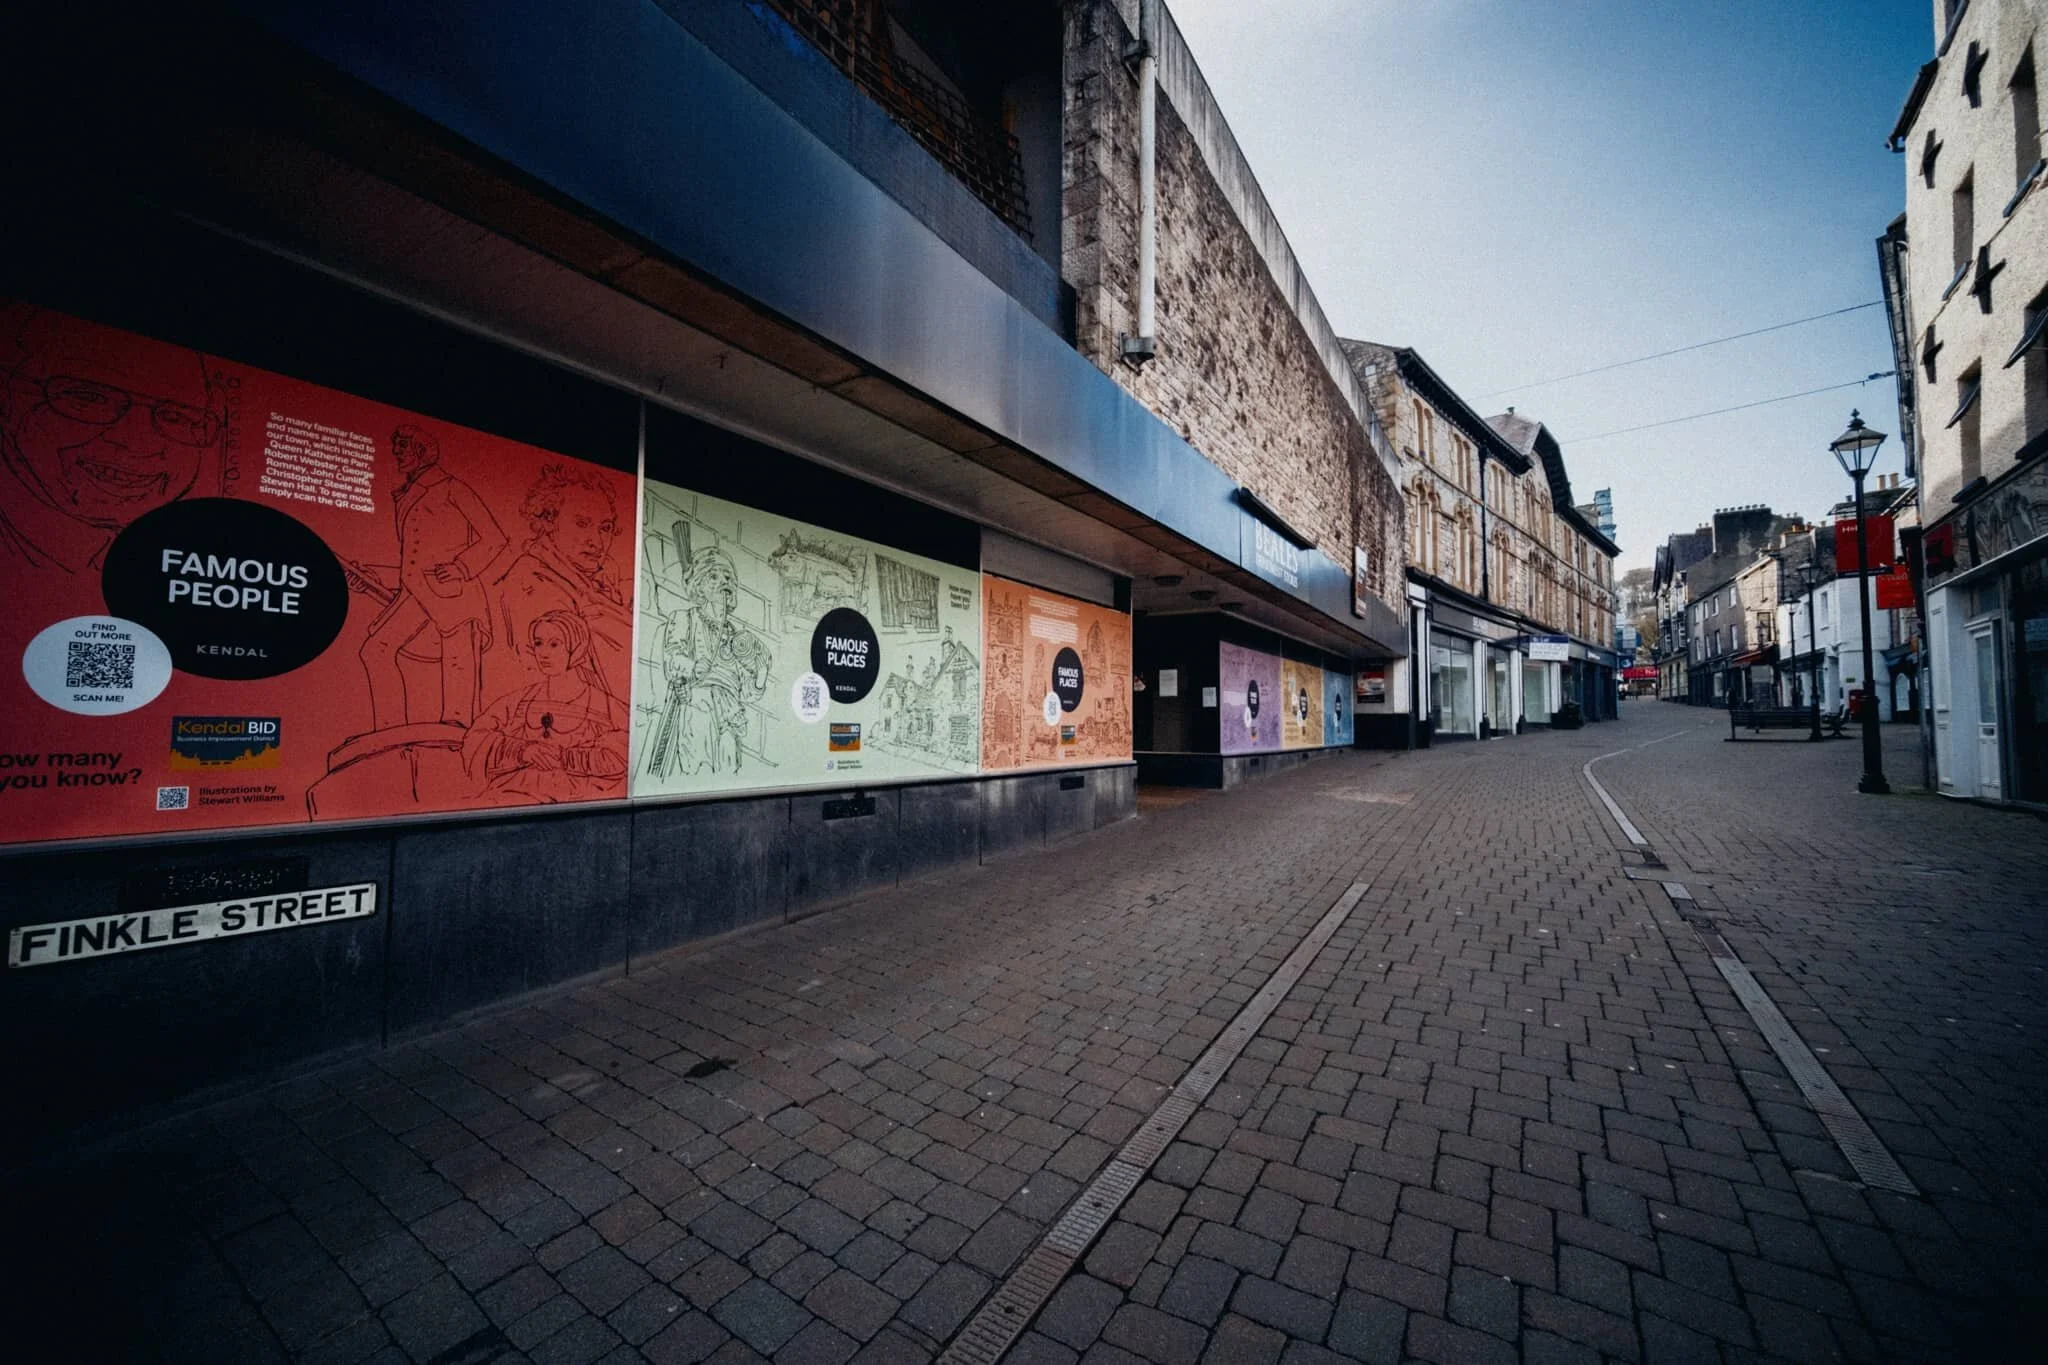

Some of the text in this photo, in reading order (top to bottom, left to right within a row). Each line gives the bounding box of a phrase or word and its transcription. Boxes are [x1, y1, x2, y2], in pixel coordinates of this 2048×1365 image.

[266, 421, 376, 453] and names are linked to
[270, 411, 373, 444] So many familiar faces
[266, 431, 283, 440] our
[312, 441, 341, 454] which
[342, 448, 375, 462] include
[270, 439, 302, 454] Queen
[304, 448, 350, 464] Katherine
[264, 447, 298, 461] Robert
[342, 465, 375, 479] George
[265, 466, 371, 496] Christopher Steele and
[311, 468, 335, 479] John
[260, 475, 295, 489] Steven
[319, 487, 331, 496] To
[331, 490, 348, 499] see
[260, 485, 375, 513] simply scan the QR code!
[161, 548, 309, 589] FAMOUS
[168, 579, 300, 615] PEOPLE
[75, 630, 132, 640] OUT MORE
[92, 623, 117, 631] FIND
[196, 644, 269, 658] KENDAL
[825, 635, 869, 654] FAMOUS
[827, 651, 866, 668] PLACES
[73, 694, 102, 702] SCAN
[178, 720, 276, 734] Kendal BID
[48, 752, 122, 770] many
[57, 768, 142, 787] know?
[200, 785, 277, 795] Illustrations by
[199, 795, 285, 805] Stewart Williams
[21, 888, 370, 961] FINKLE STREET
